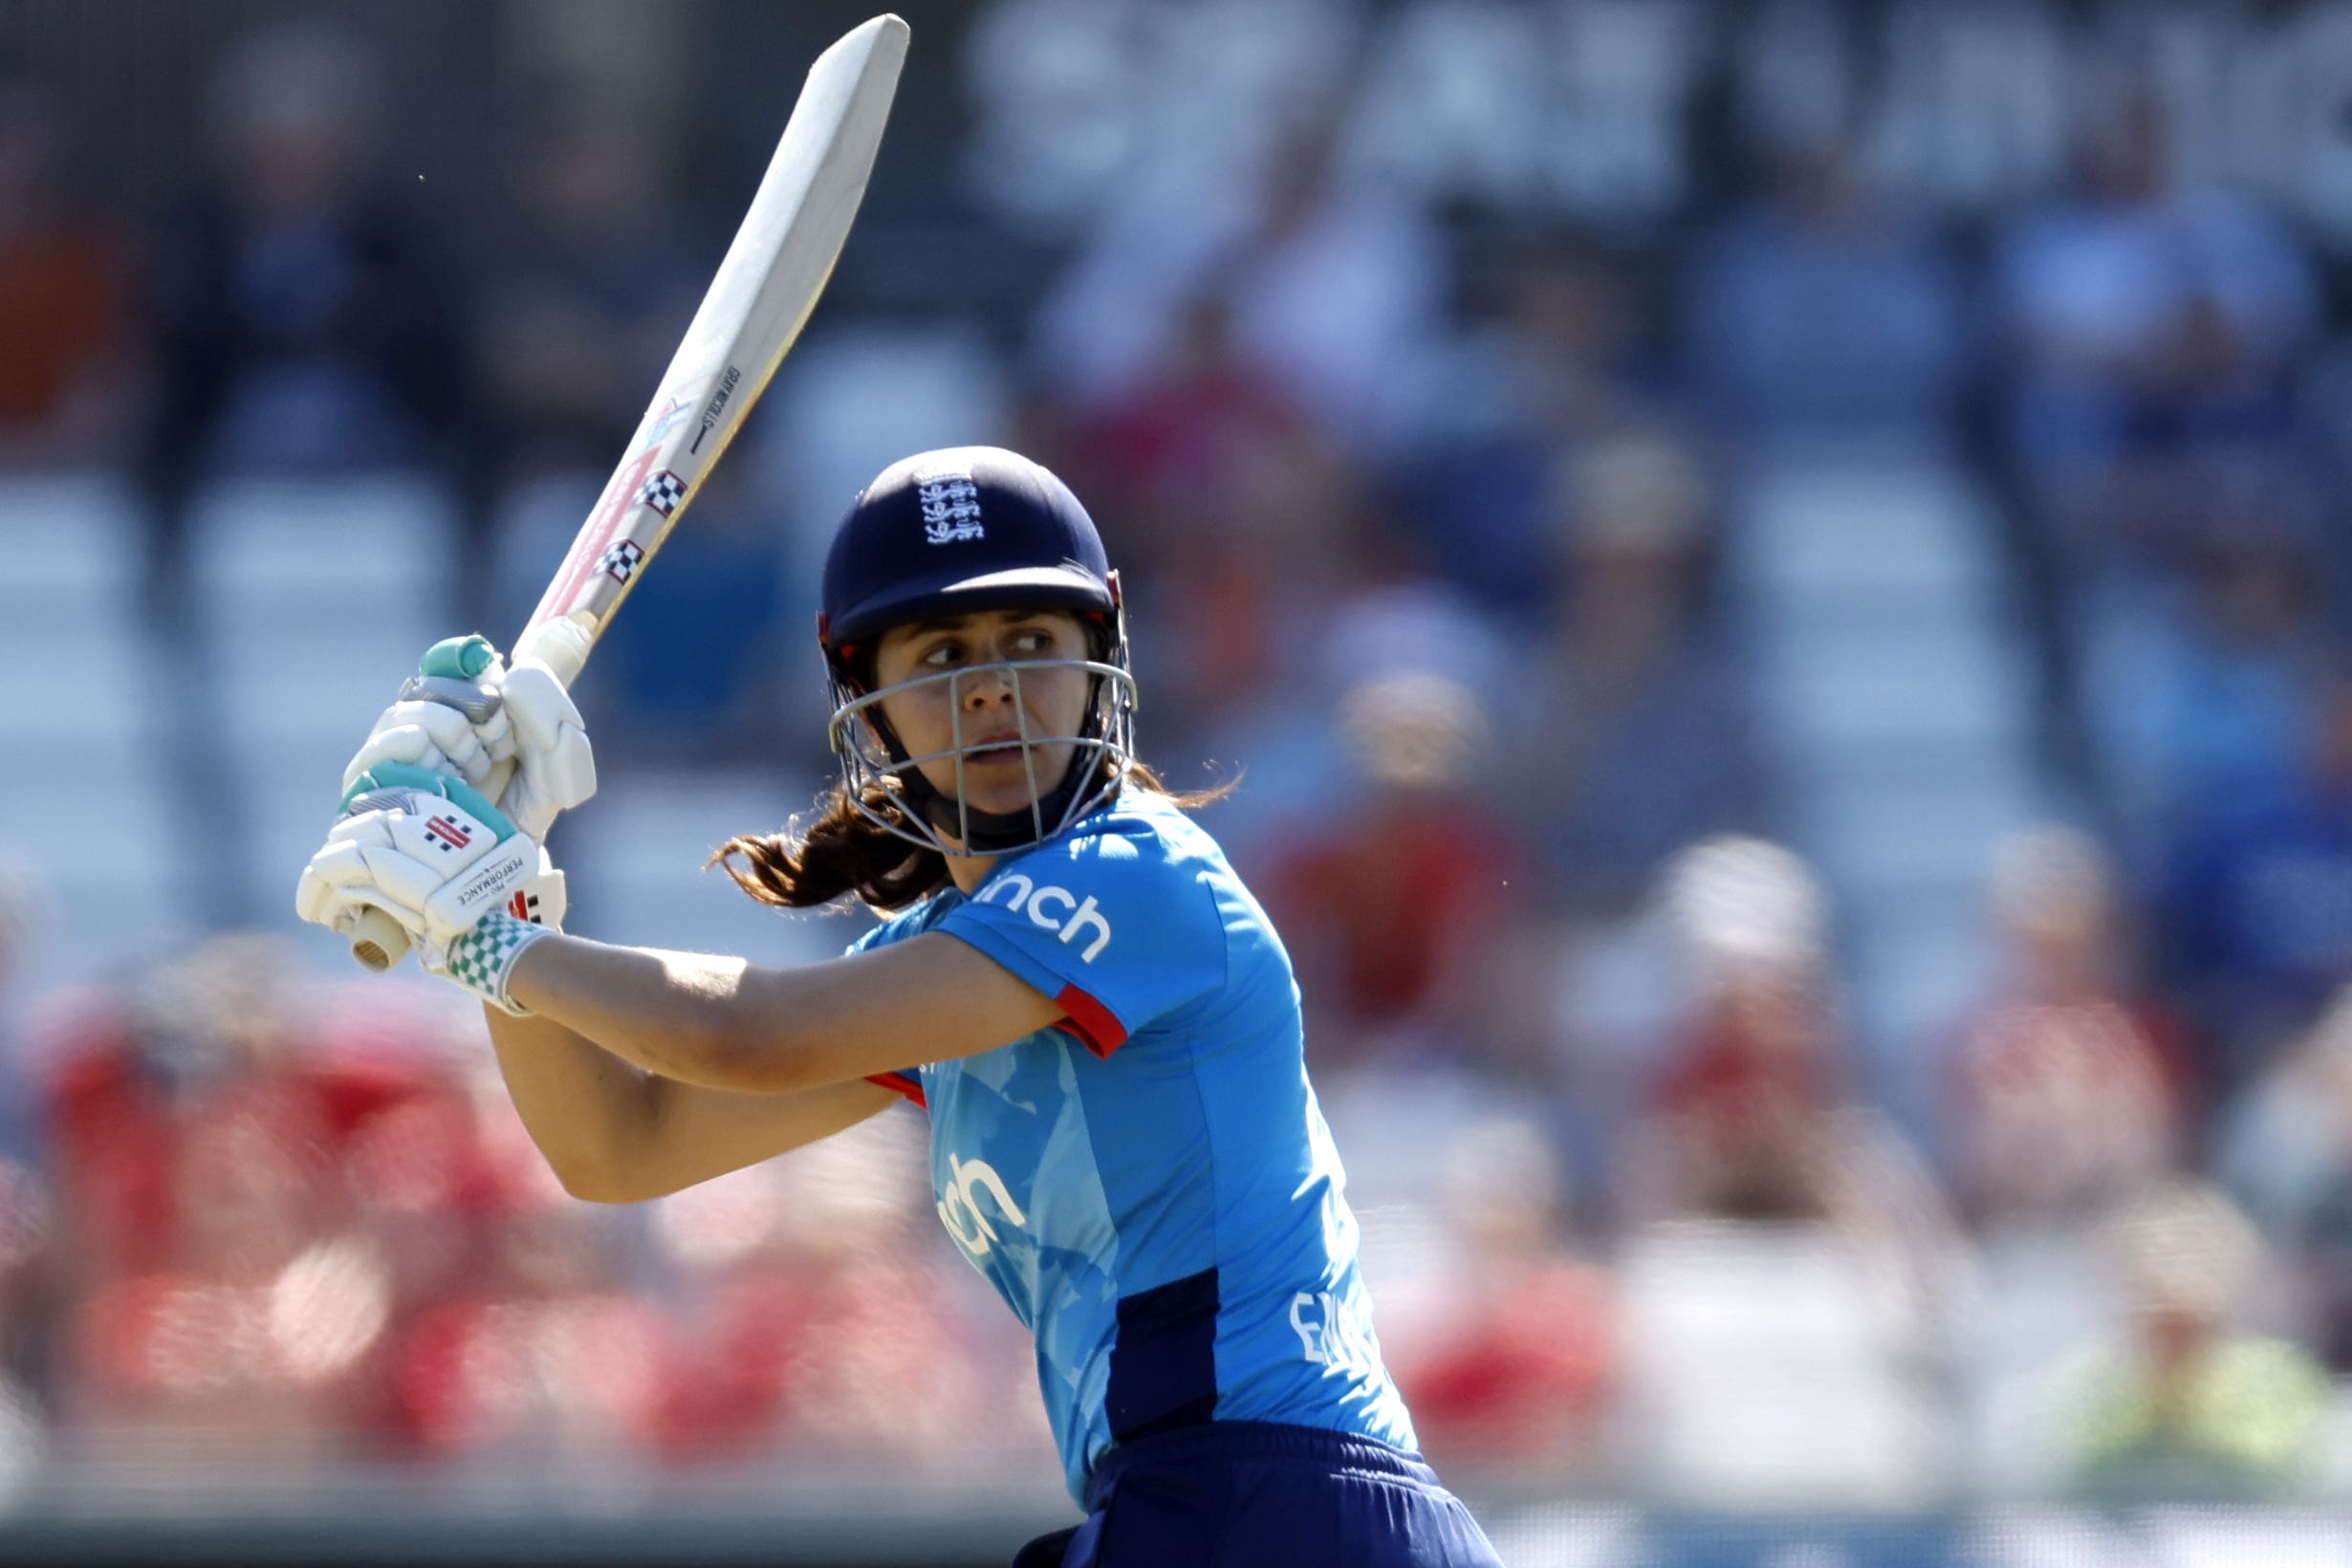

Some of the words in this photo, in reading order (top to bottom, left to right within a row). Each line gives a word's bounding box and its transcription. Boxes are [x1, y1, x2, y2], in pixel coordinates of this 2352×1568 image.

[722, 366, 741, 394] GRAY
[457, 857, 524, 905] PERFORMANCE
[490, 882, 505, 895] PRO
